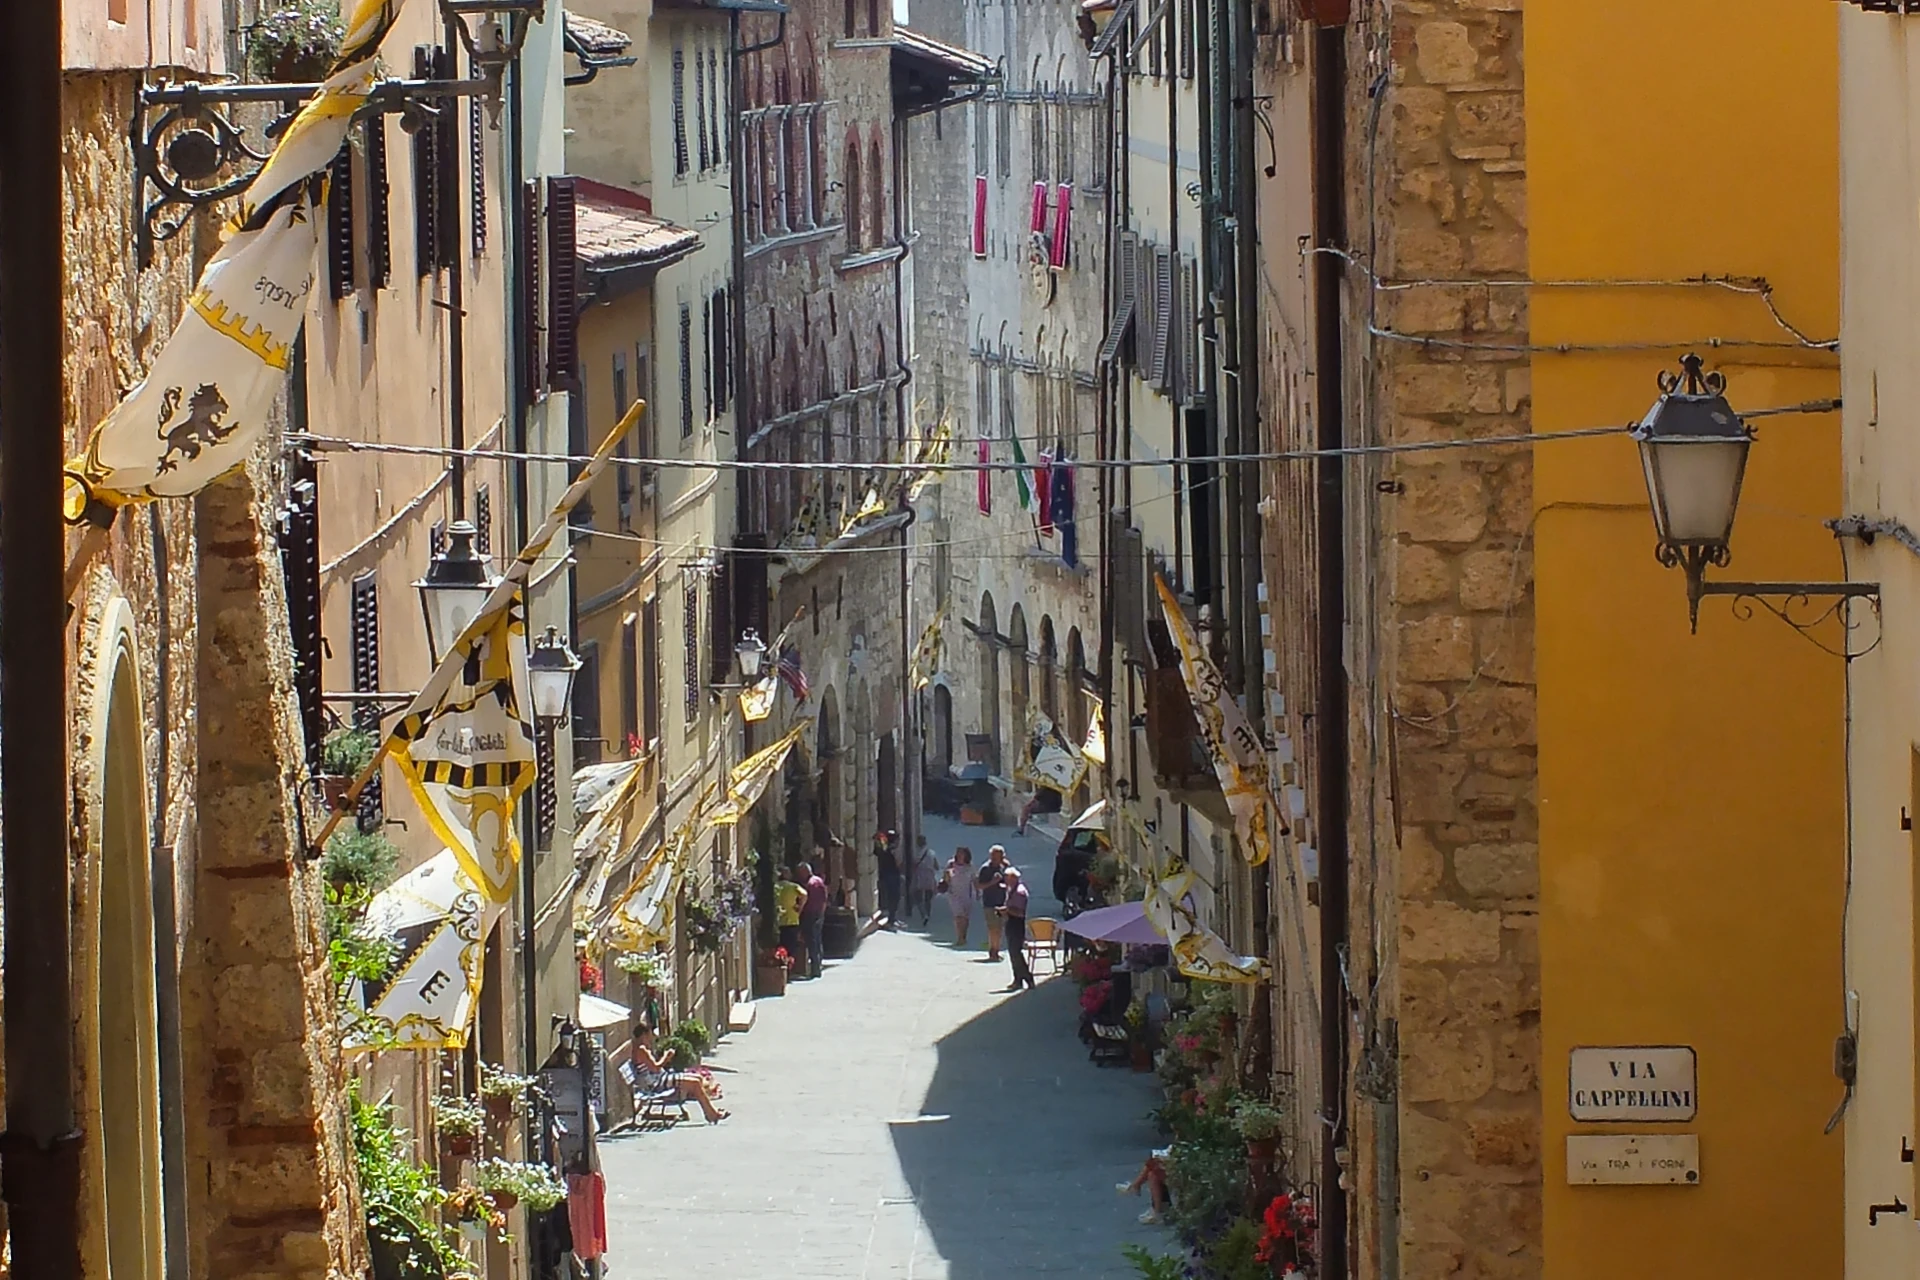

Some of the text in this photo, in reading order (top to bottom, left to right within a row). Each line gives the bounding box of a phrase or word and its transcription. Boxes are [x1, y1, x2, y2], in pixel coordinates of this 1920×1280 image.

[1608, 1061, 1656, 1078] VIA
[1575, 1090, 1691, 1107] CAPPELLINI
[1608, 1160, 1631, 1169] TRA
